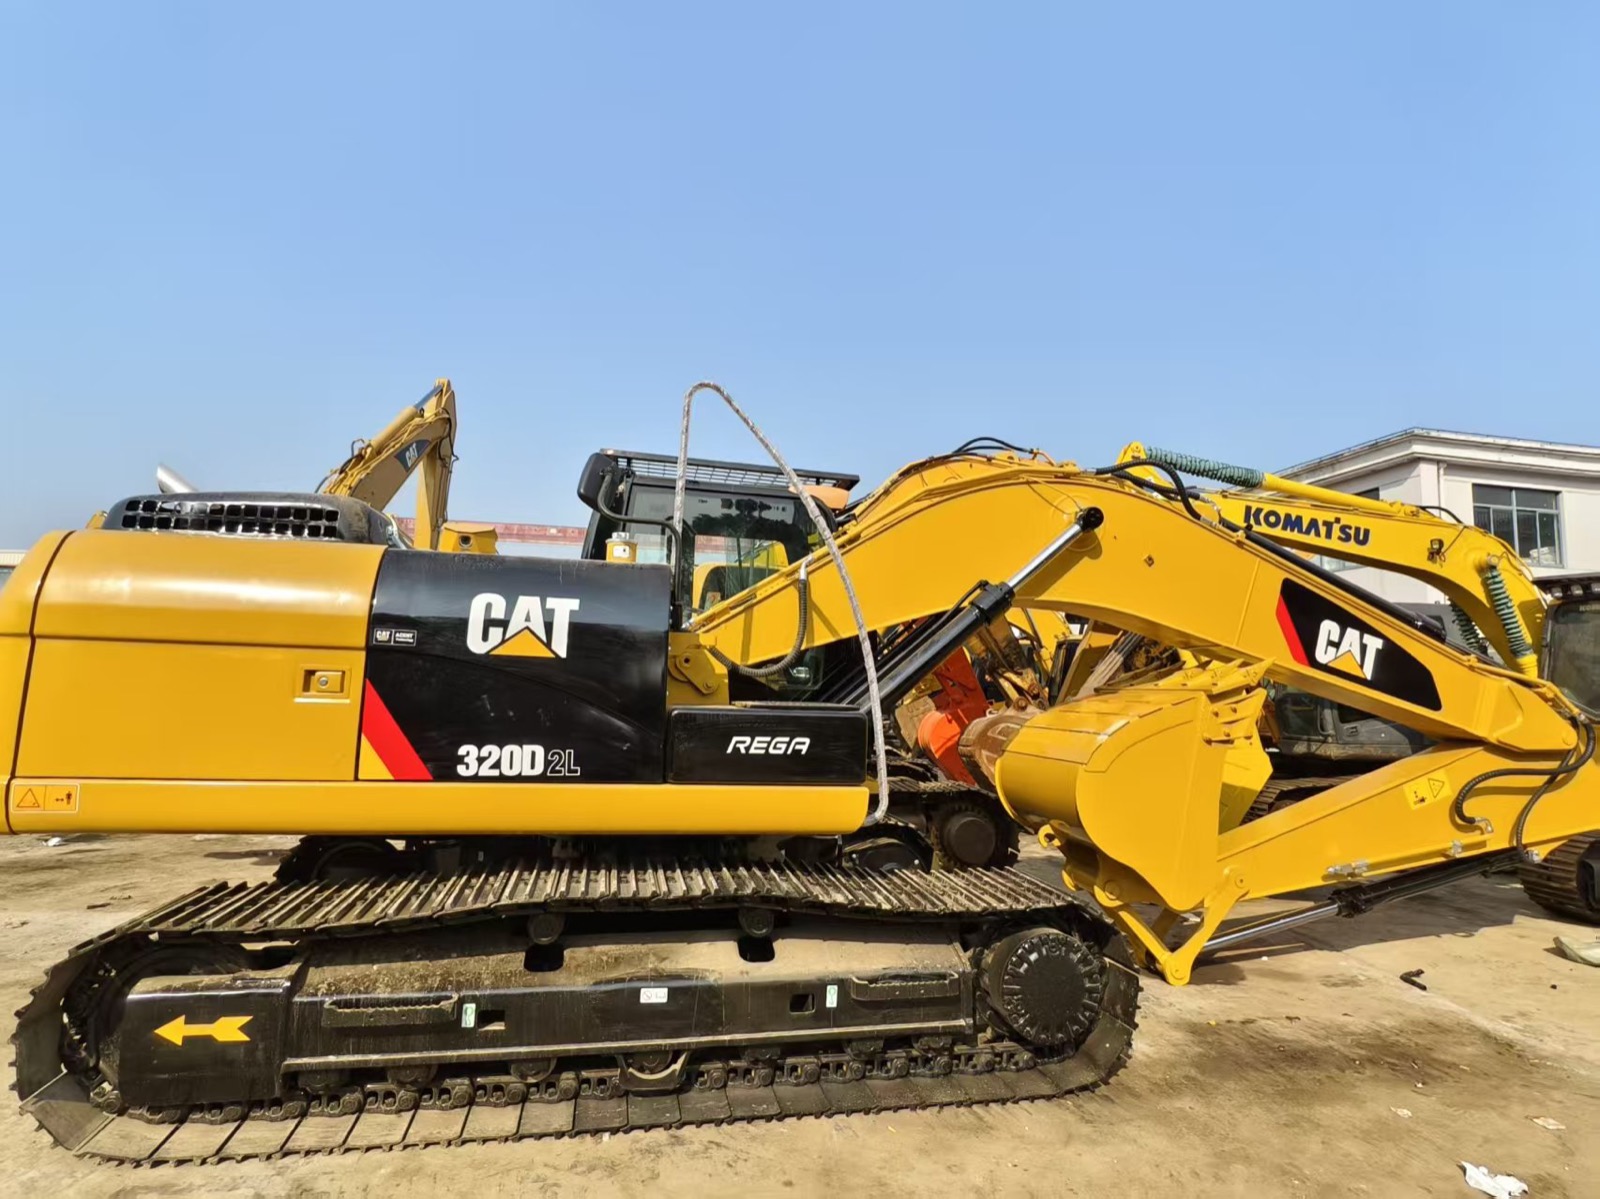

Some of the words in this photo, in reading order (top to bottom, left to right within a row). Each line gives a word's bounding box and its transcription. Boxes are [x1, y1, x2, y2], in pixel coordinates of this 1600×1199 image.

[1243, 504, 1371, 546] KOMATSU
[376, 630, 391, 641] CAT
[466, 592, 581, 659] CAT
[1314, 618, 1384, 681] CAT
[456, 744, 545, 777] 320D
[547, 749, 581, 776] 2L
[726, 735, 811, 755] REGA
